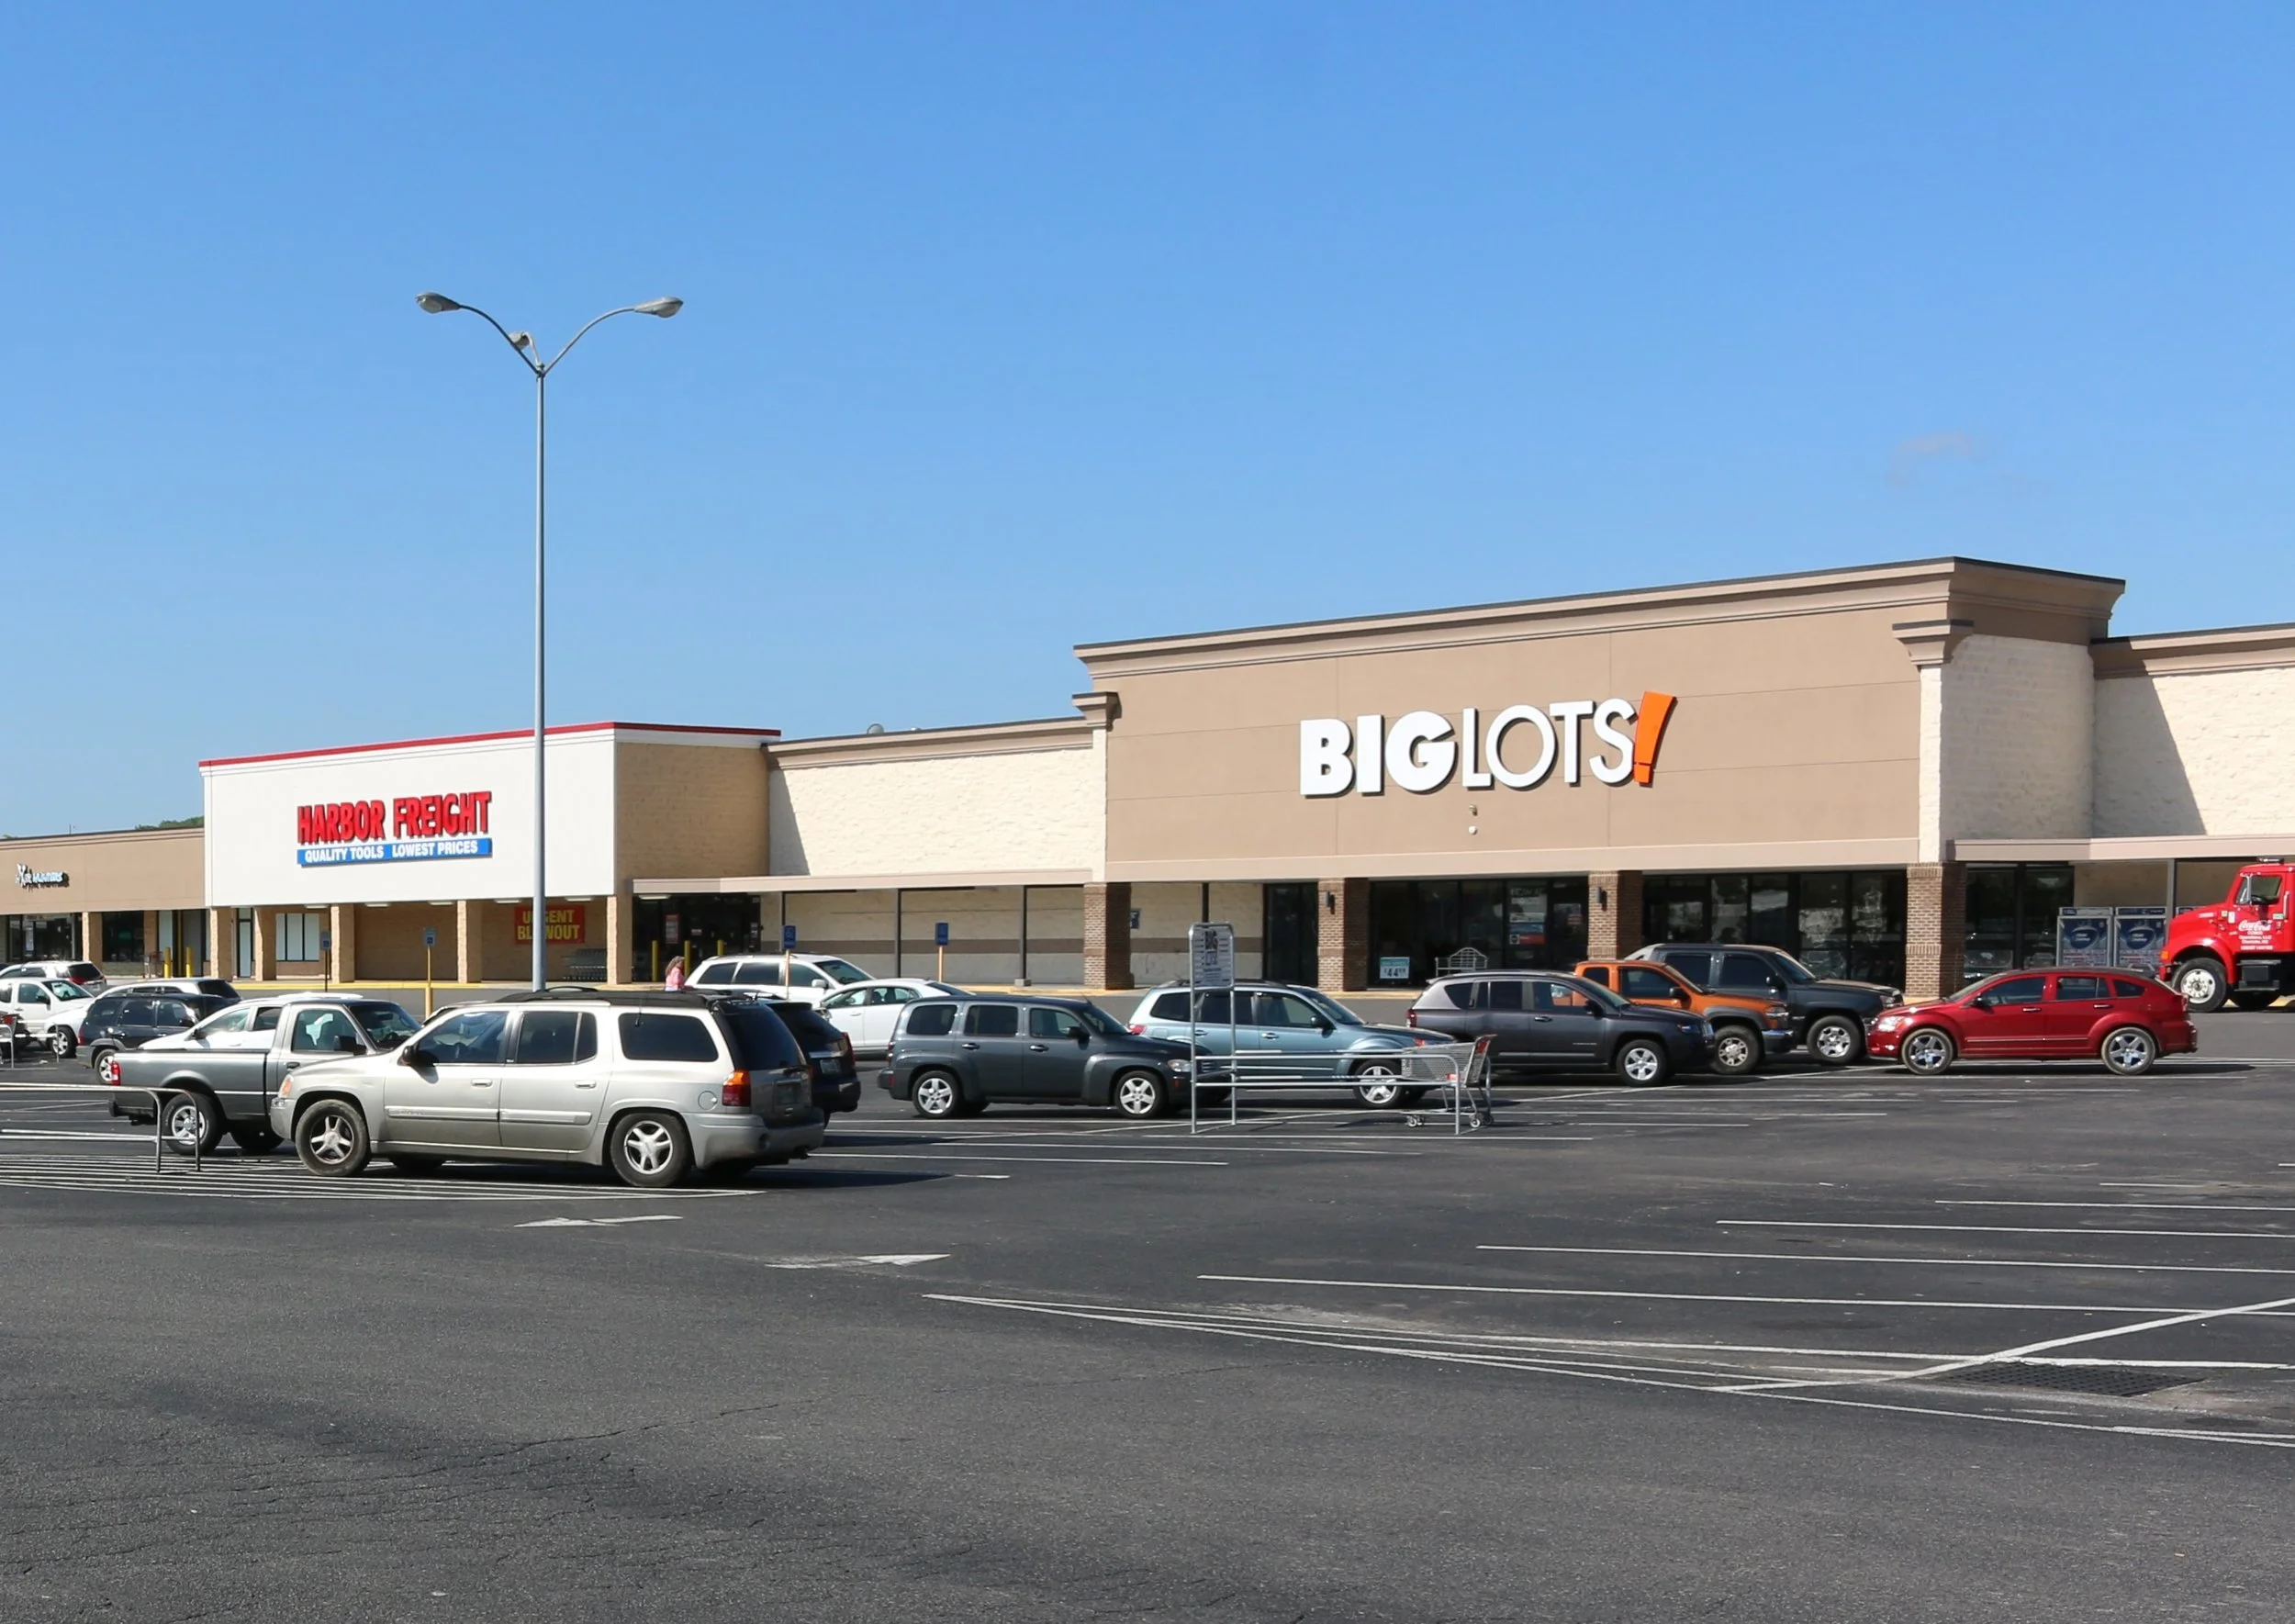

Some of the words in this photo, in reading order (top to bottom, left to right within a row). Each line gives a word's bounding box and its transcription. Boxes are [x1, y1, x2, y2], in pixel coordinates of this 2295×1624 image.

[297, 800, 386, 845] HARBOR
[393, 791, 492, 838] FREIGHT
[305, 847, 348, 863] QUALITY
[350, 846, 384, 860] TOOLS
[392, 842, 435, 857] LOWEST
[437, 840, 478, 855] PRICES
[522, 910, 575, 924] UENT
[518, 924, 580, 940] BLWOUT
